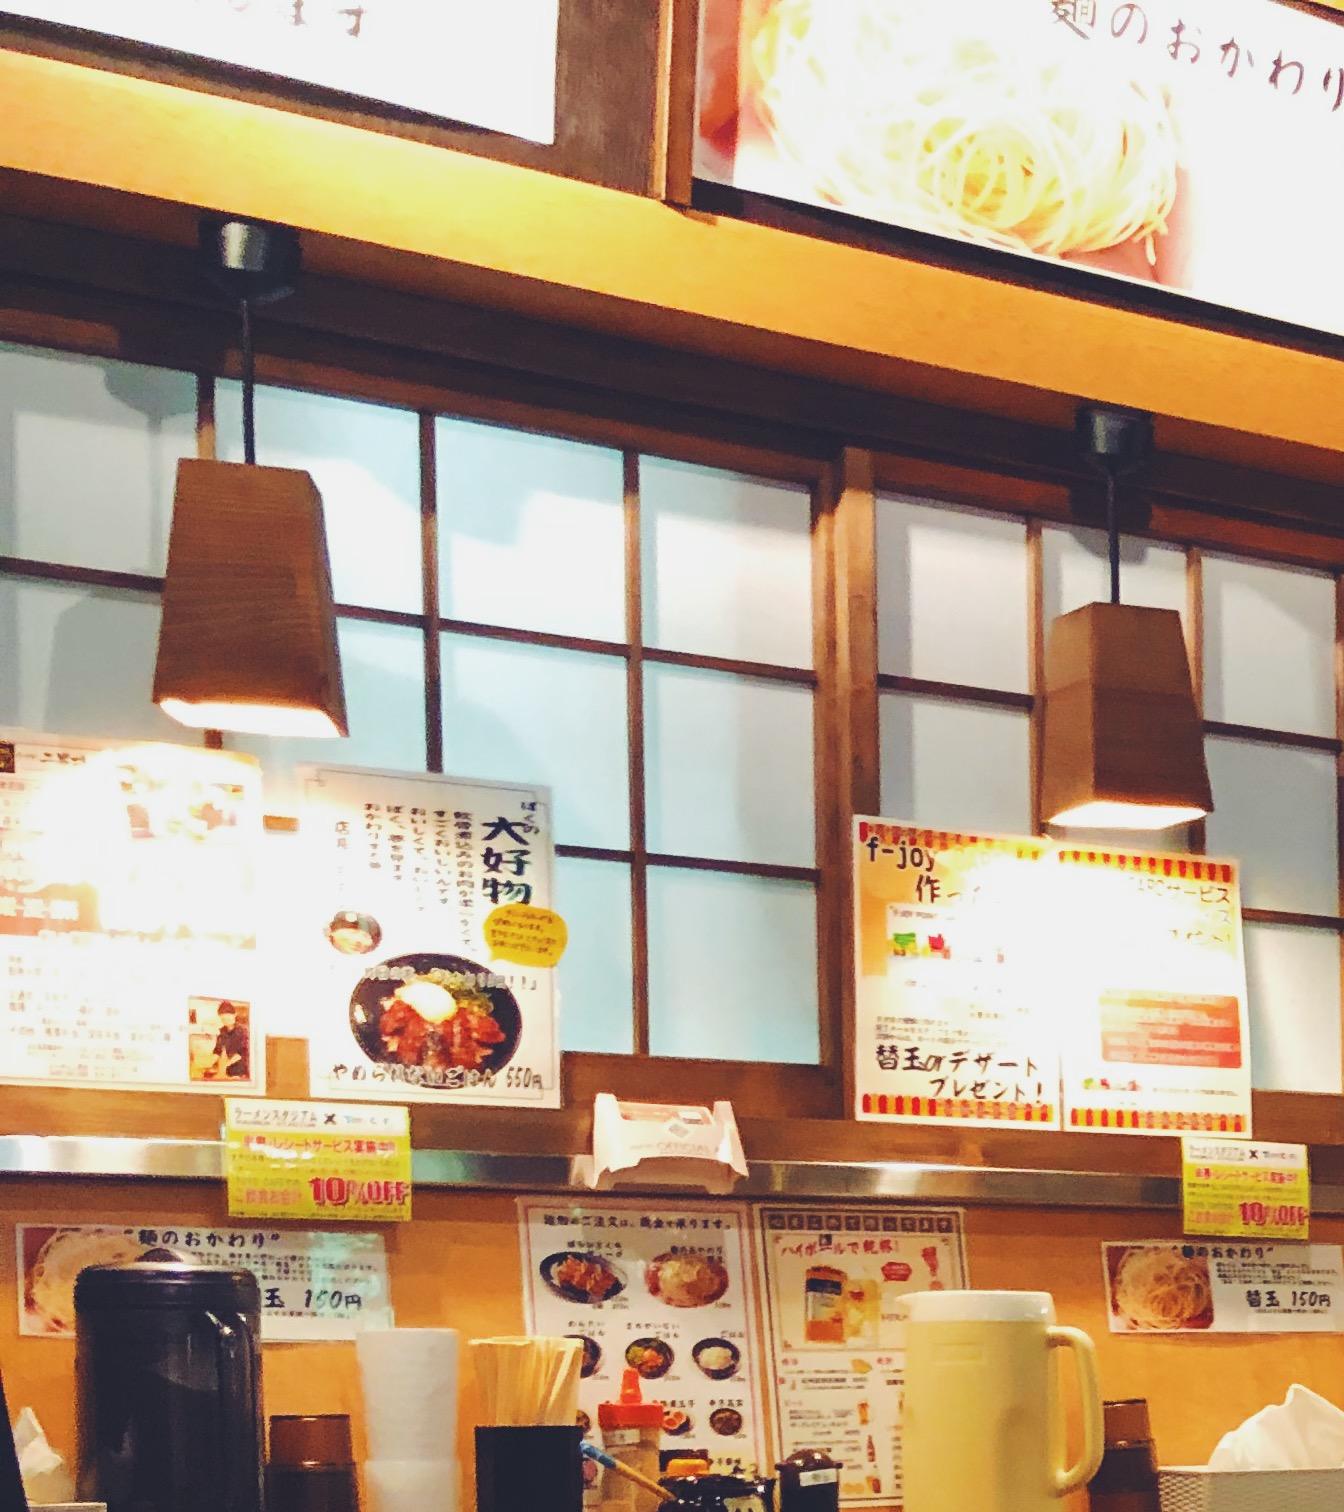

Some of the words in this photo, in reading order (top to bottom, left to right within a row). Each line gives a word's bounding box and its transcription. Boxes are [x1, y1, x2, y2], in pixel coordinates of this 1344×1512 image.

[481, 816, 533, 905] 大好物
[506, 1066, 543, 1090] 550円
[1290, 1289, 1332, 1308] 150円
